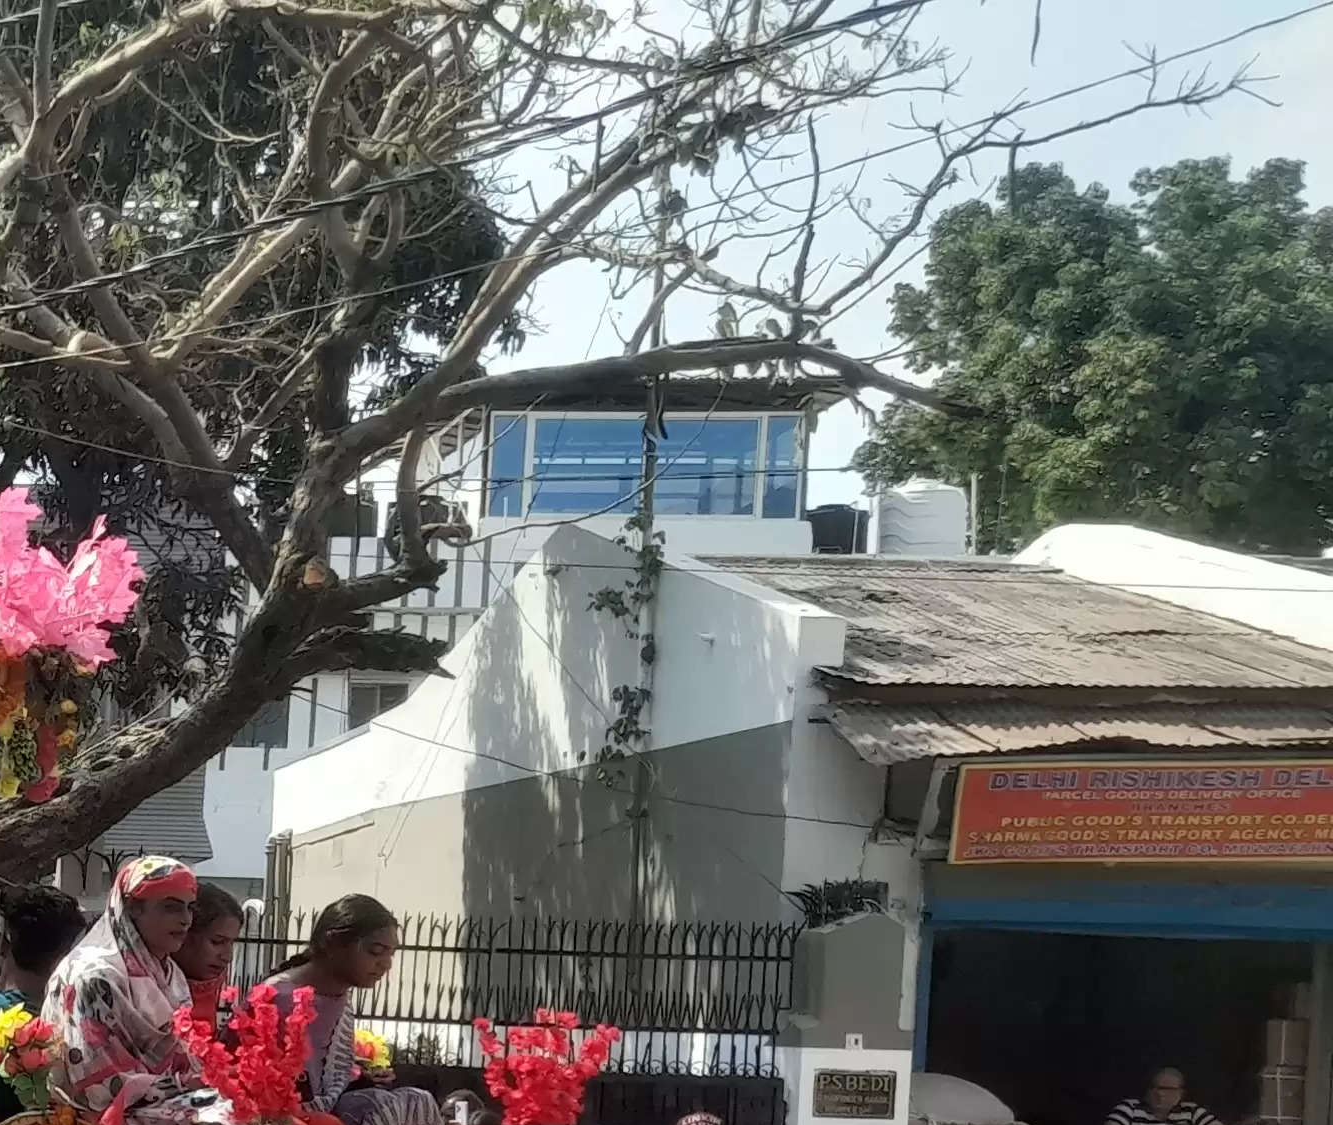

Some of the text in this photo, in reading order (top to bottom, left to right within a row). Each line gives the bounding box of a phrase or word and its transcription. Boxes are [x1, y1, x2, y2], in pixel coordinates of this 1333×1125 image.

[989, 767, 1333, 791] DELHI RISHIKESH DEL
[1149, 814, 1265, 827] TRANSPORT
[1116, 829, 1224, 841] TRANSPORT
